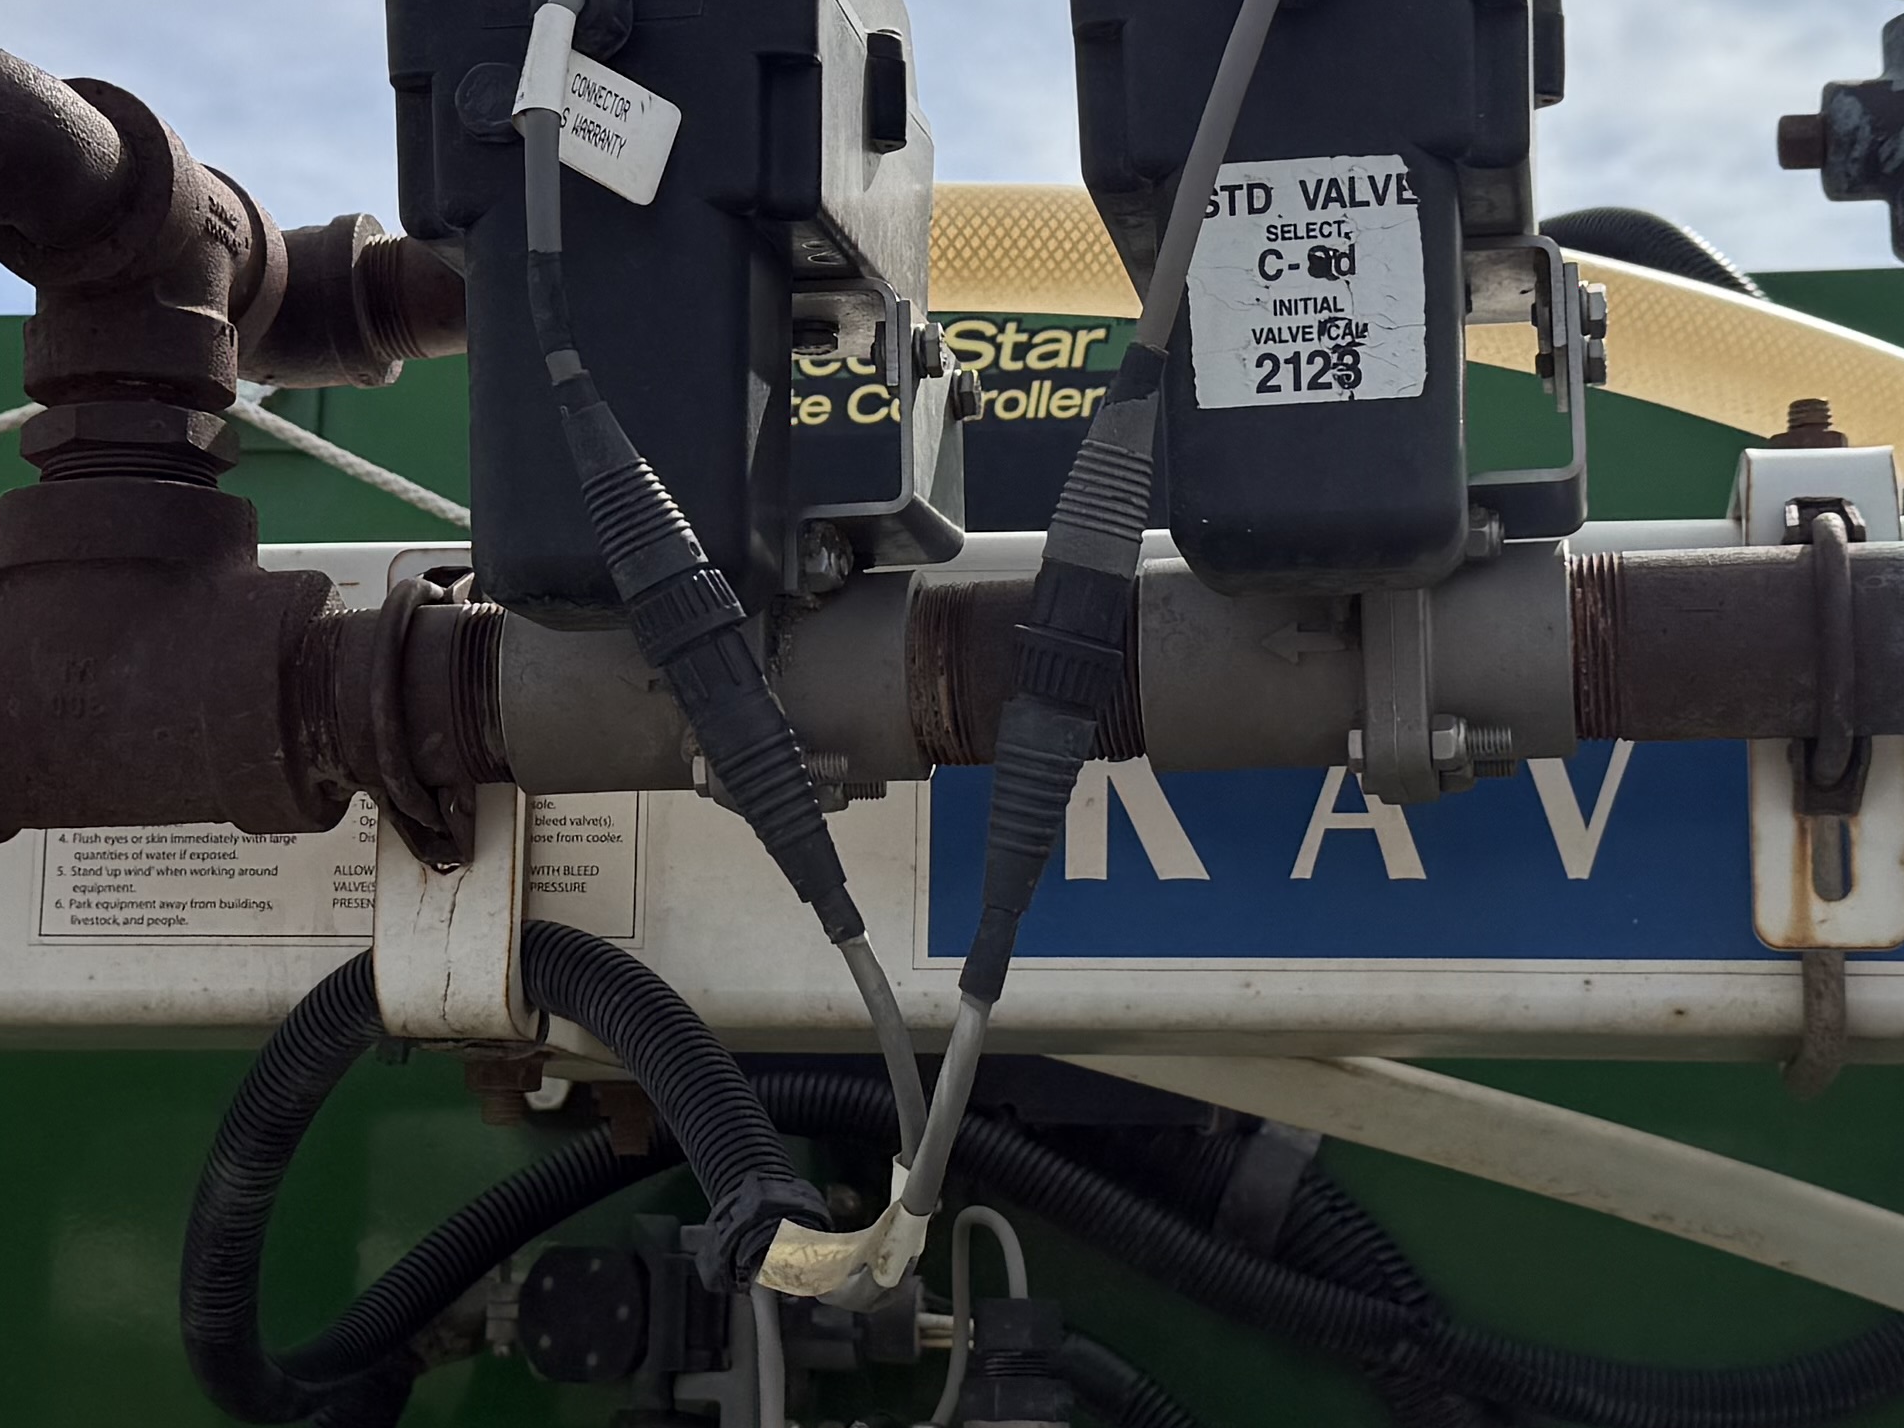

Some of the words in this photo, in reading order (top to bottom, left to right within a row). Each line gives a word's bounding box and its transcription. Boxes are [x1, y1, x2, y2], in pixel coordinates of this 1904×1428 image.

[571, 73, 631, 122] CONNECTOR
[571, 113, 627, 159] WARRANTY
[1204, 182, 1274, 219] STD
[1299, 173, 1420, 211] VALVE
[1266, 220, 1345, 242] SELECT
[1273, 296, 1345, 317] INITIAL
[1252, 325, 1314, 344] VALVE
[1326, 322, 1368, 341] CAL
[535, 816, 566, 826] bleed
[59, 834, 68, 844] 4.
[72, 834, 101, 844] Flush
[104, 835, 128, 846] eyes
[131, 836, 143, 844] or
[146, 834, 167, 844] skin
[170, 833, 240, 847] immediately
[556, 833, 583, 843] from
[586, 833, 623, 843] cooler.
[74, 851, 129, 863] quantities
[132, 850, 144, 860] of
[146, 851, 176, 860] water
[179, 850, 187, 860] if
[189, 850, 239, 863] exposed.
[57, 867, 67, 876] 5.
[70, 866, 102, 877] Stand
[156, 866, 187, 877] when
[190, 866, 235, 879] working
[237, 866, 278, 877] around
[334, 865, 376, 876] ALLOW
[531, 866, 560, 876] WITH
[563, 866, 599, 876] BLEED
[72, 883, 136, 895] equipment.
[530, 882, 587, 893] PRESSURE
[55, 900, 64, 909] 6.
[69, 900, 92, 909] Park
[95, 900, 156, 912] equipment
[159, 901, 187, 912] away
[190, 900, 216, 909] from
[123, 916, 144, 926] and
[147, 916, 188, 928] people.
